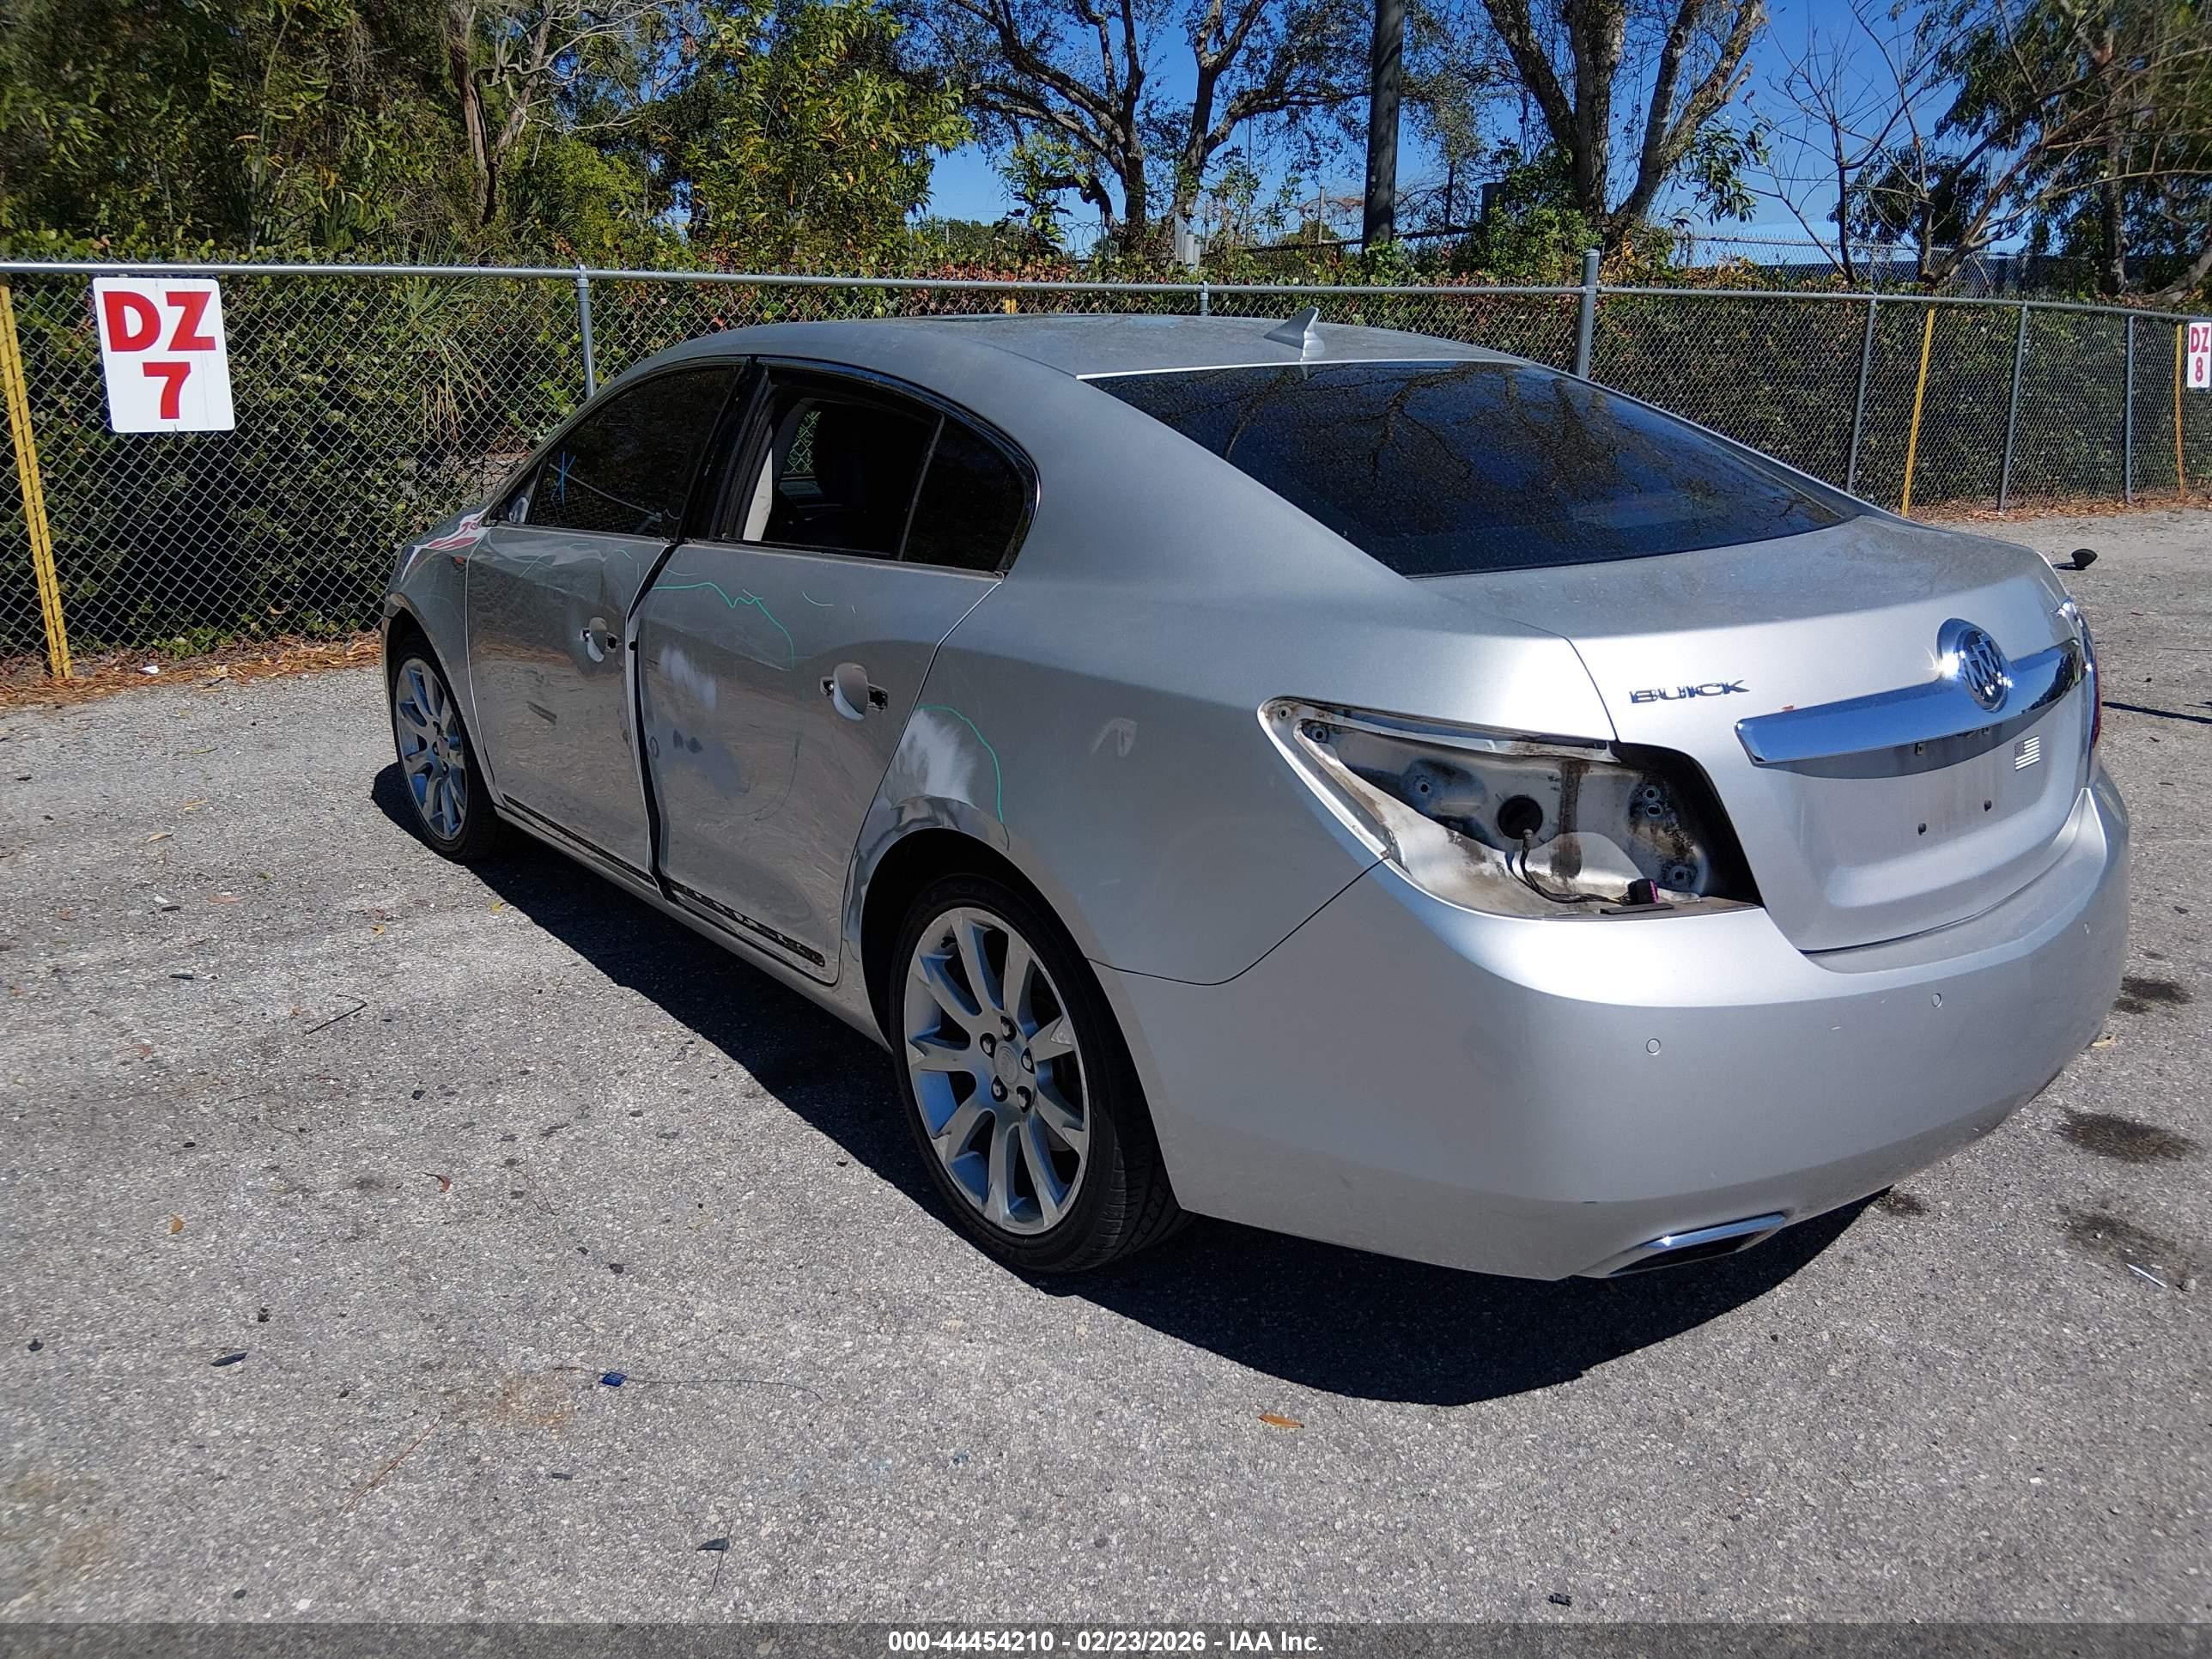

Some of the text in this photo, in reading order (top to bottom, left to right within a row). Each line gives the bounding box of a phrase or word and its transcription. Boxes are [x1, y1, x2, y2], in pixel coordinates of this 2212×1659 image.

[102, 291, 216, 352] DZ
[2191, 327, 2209, 353] DZ
[2195, 356, 2203, 382] 8
[142, 362, 191, 420] 7
[1628, 679, 1750, 704] BUICK
